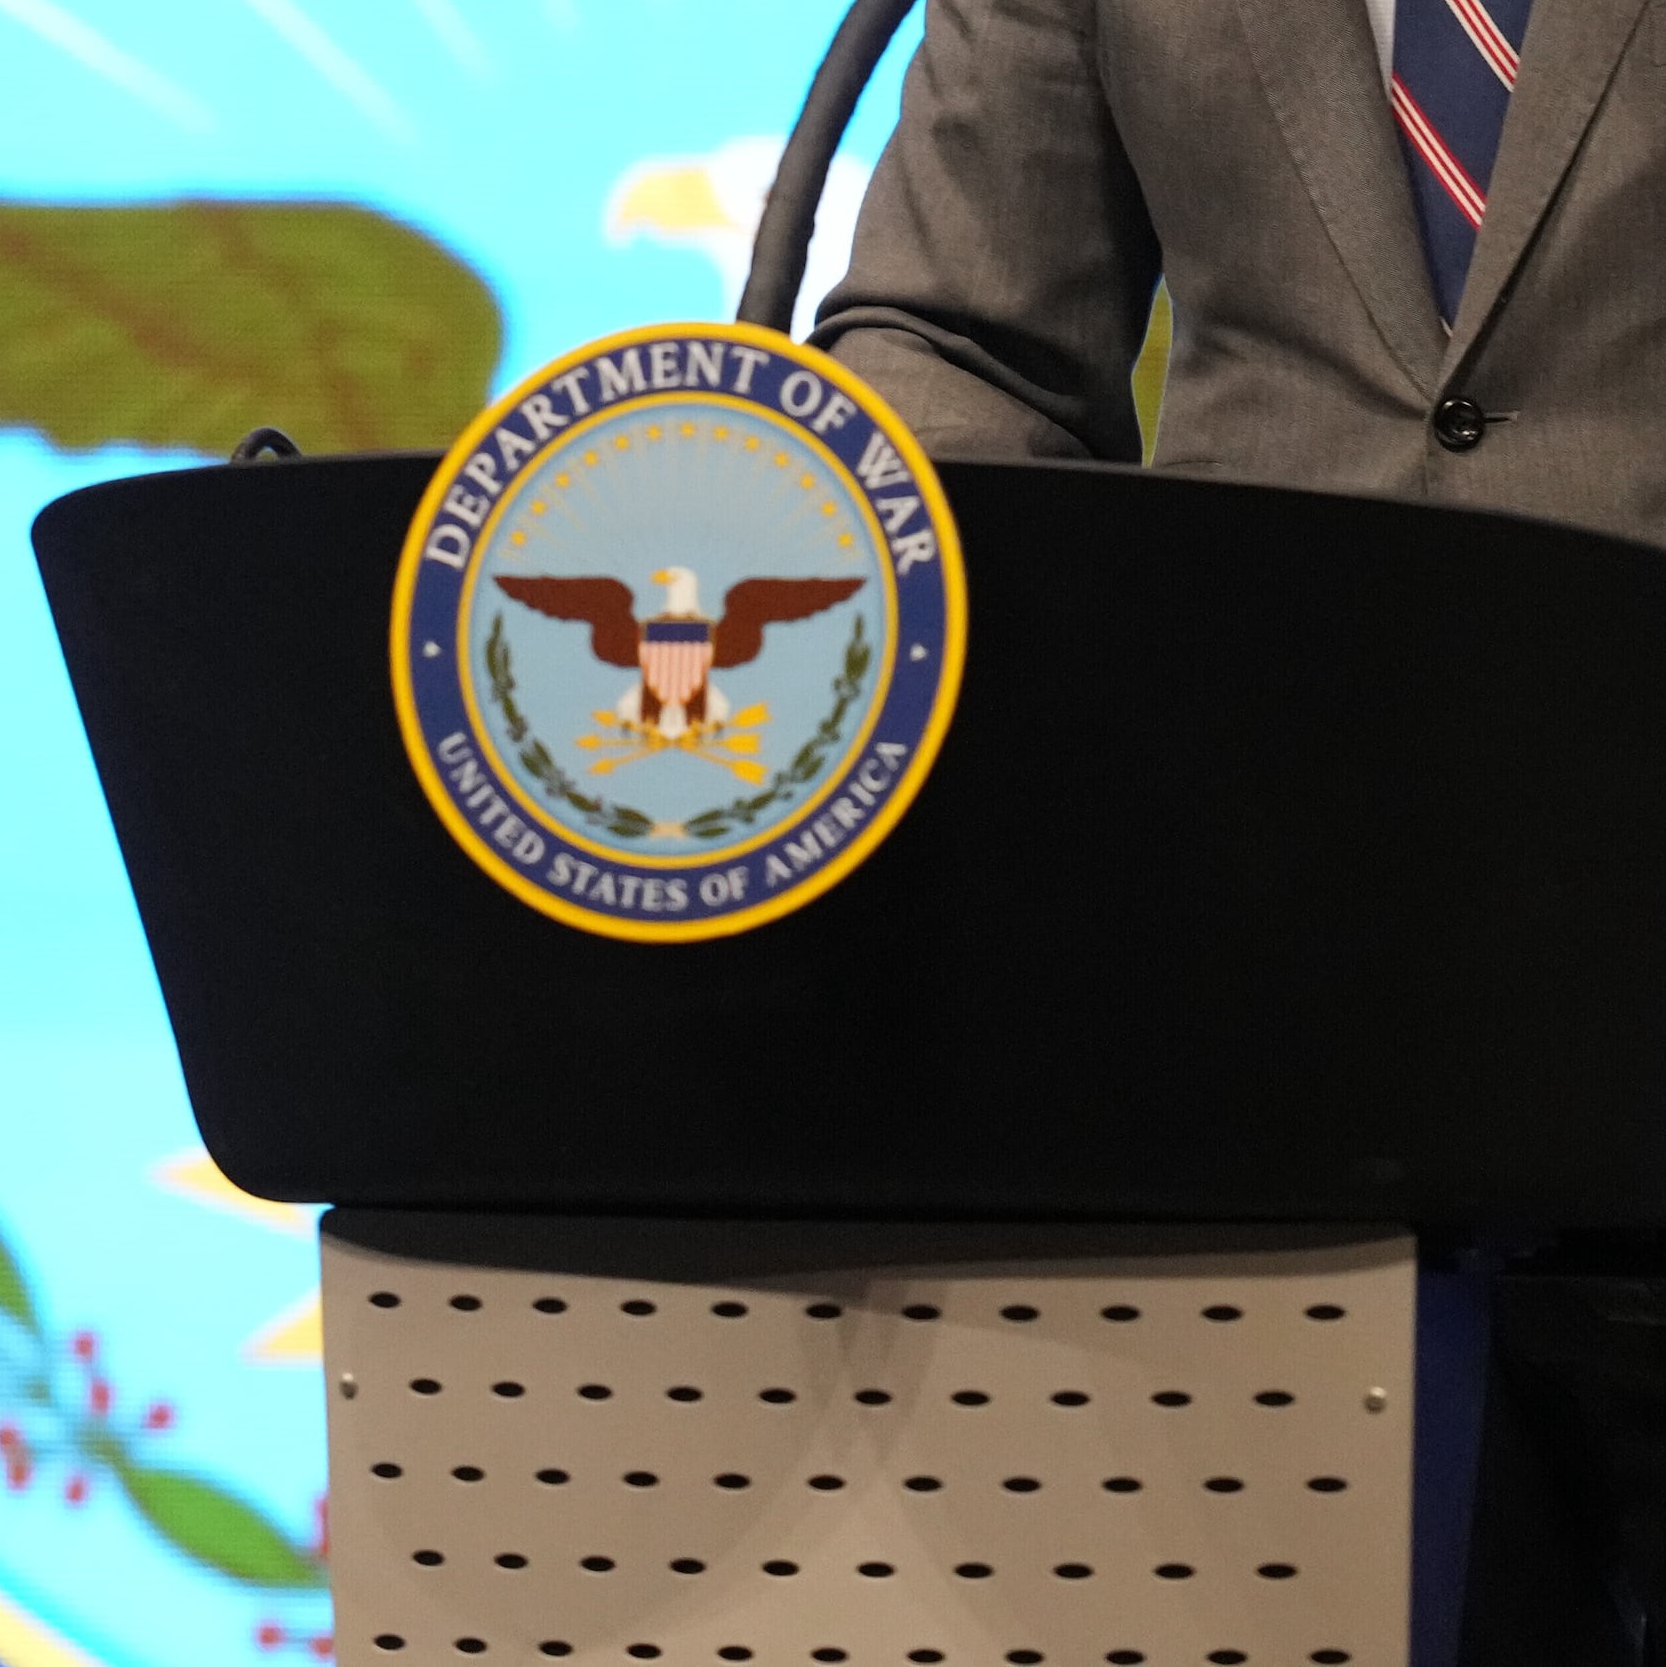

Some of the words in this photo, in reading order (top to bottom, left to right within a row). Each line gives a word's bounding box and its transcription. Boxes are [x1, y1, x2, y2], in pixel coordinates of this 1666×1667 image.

[424, 340, 770, 570] DEPARTMENT
[779, 370, 858, 434] OF
[856, 430, 937, 575] WAR
[438, 731, 546, 864] UNITED
[547, 852, 689, 912] STATES
[699, 866, 749, 907] OF
[765, 741, 908, 888] AMERICA
